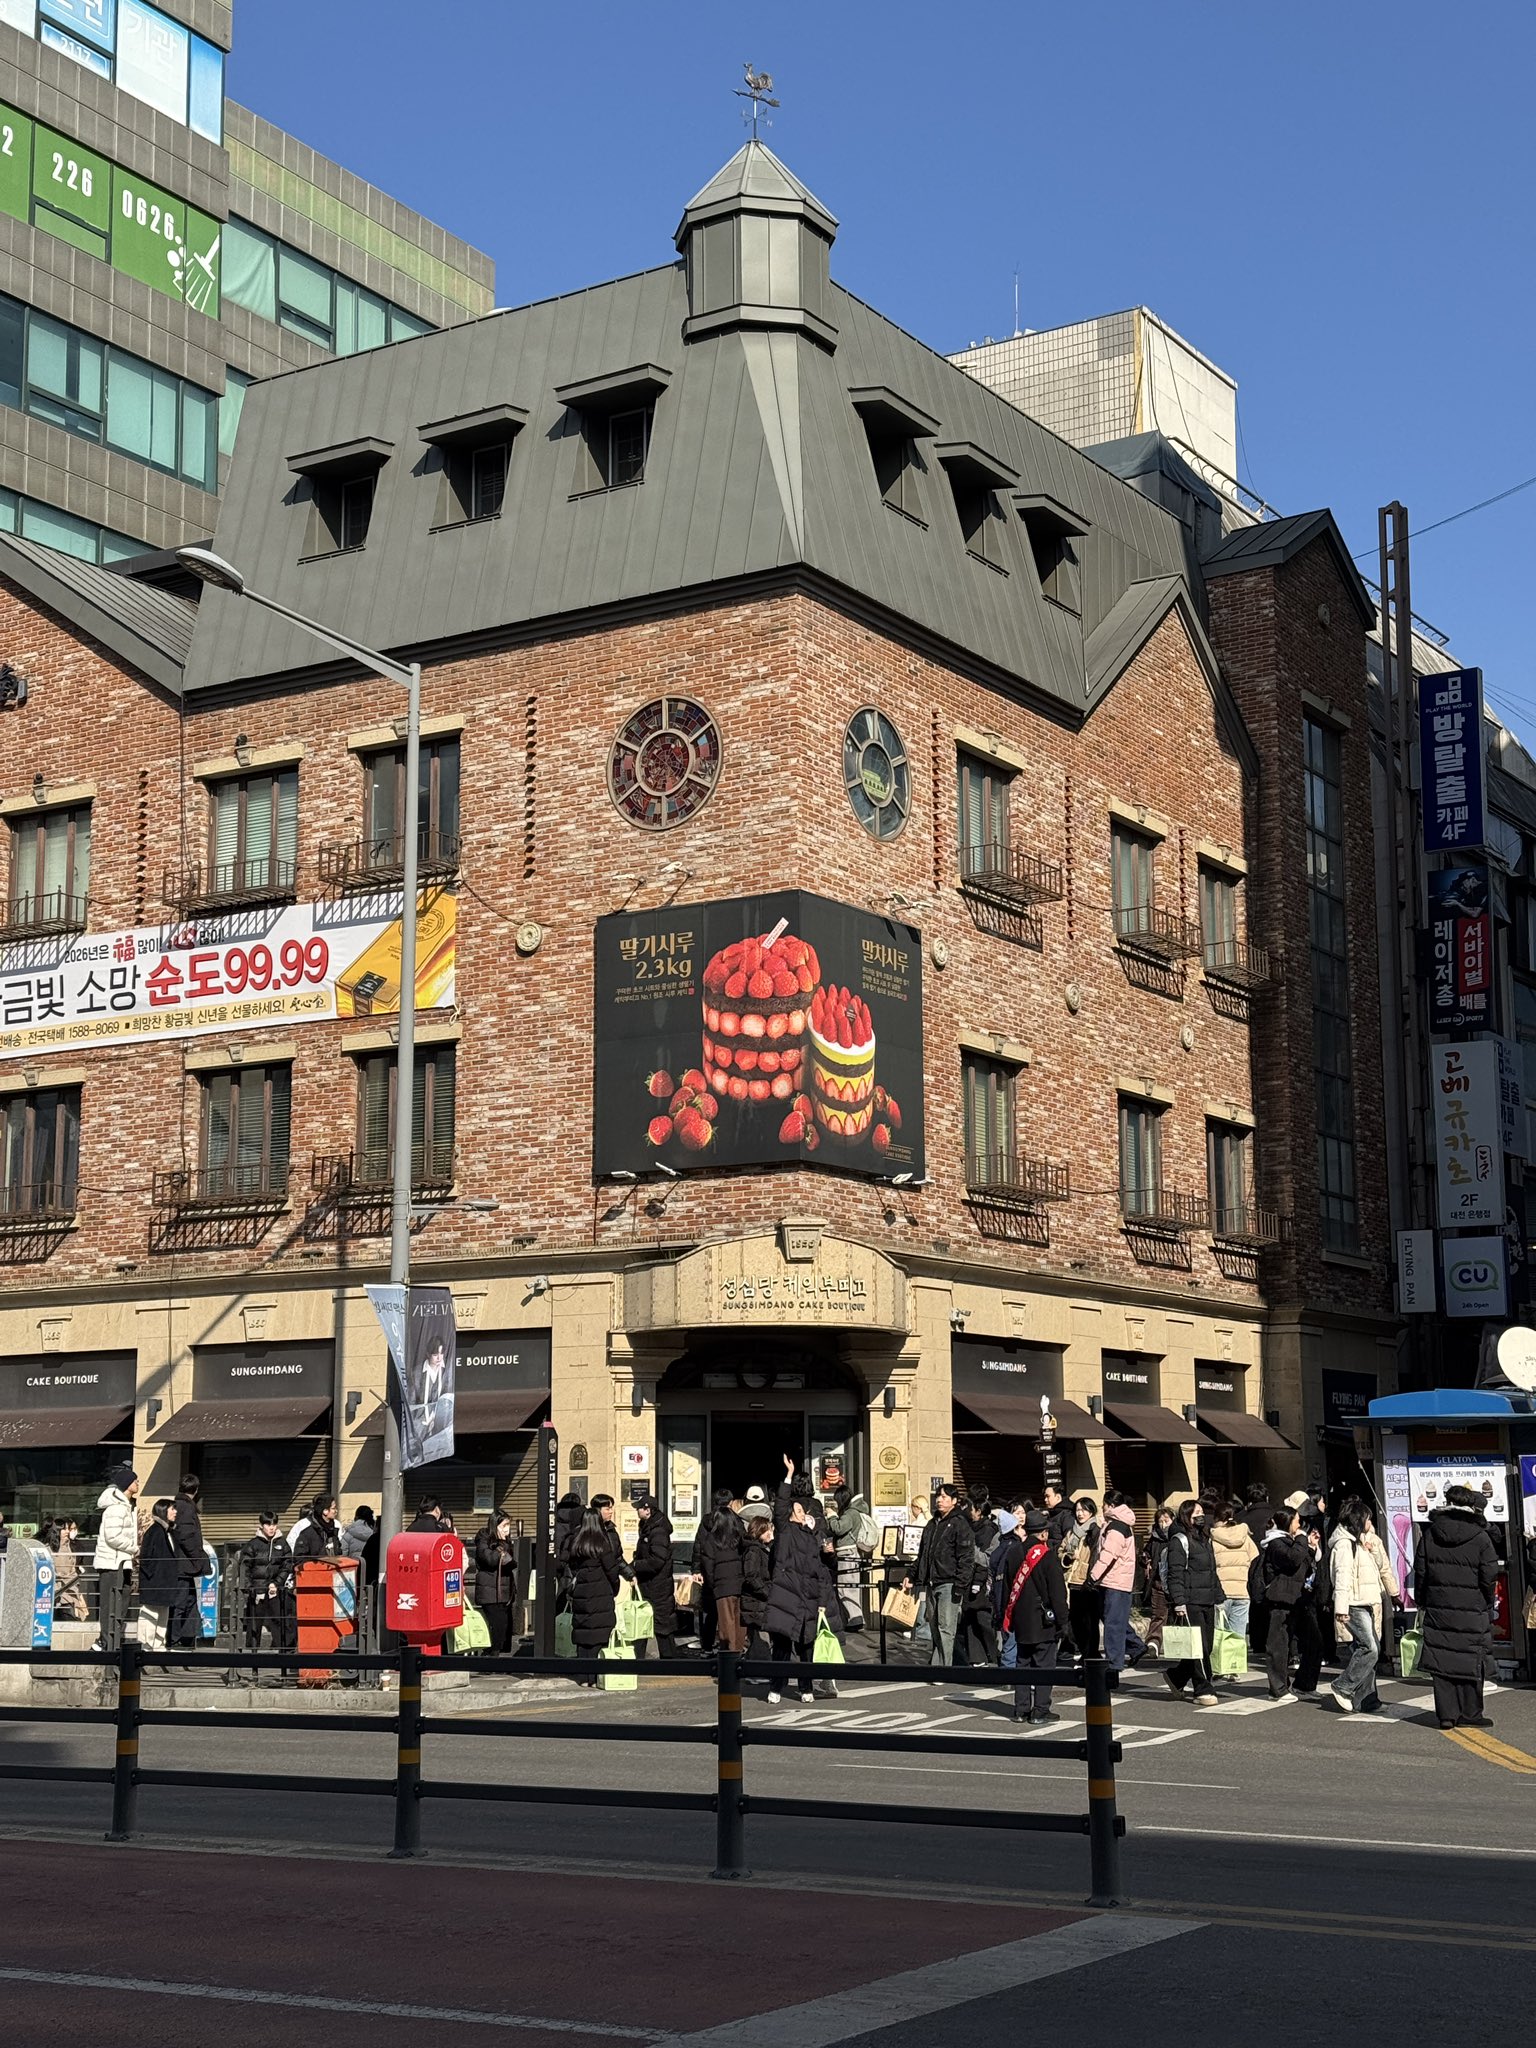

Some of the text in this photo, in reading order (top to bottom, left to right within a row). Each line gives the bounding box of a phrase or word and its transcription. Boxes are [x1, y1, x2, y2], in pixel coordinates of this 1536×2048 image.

[52, 152, 93, 197] 226
[122, 189, 175, 241] 0626
[1433, 712, 1467, 805] 방탈출
[1436, 805, 1469, 823] 카페
[1442, 823, 1467, 841] 4F
[64, 944, 109, 964] 2026년은
[112, 934, 136, 963] 福
[620, 931, 696, 961] 딸기시루
[1464, 921, 1484, 987] 서바이벌
[862, 939, 909, 974] 말차시루
[1434, 919, 1455, 1006] 레이저총
[635, 957, 692, 980] 2.3kg
[0, 936, 329, 1026] 금빛 소망 순도99.99
[1459, 993, 1487, 1010] 배틀
[68, 1021, 120, 1038] 1588-8069
[132, 1014, 162, 1031] 희망찬
[164, 1010, 194, 1028] 황금빛
[197, 1006, 228, 1023] 신년을
[231, 1000, 286, 1020] 선물하세요!
[1461, 1194, 1479, 1206] 2F
[1450, 1211, 1466, 1219] 대전
[1404, 1238, 1416, 1305] FLYING PAN
[1458, 1268, 1488, 1284] CU
[720, 1275, 778, 1299] 성심당
[722, 1301, 795, 1310] SUNGSIMDANG
[799, 1301, 825, 1310] CAKE
[1474, 1302, 1490, 1310] Open
[466, 1354, 520, 1366] BOUTIQUE
[230, 1364, 303, 1377] SUNGSIMDANG
[1105, 1371, 1121, 1381] CAKE
[26, 1374, 99, 1387] CAKE BOUTIQUE
[1332, 1392, 1352, 1406] FLYING
[1436, 1456, 1478, 1464] GELATOYA
[40, 1571, 50, 1579] D1
